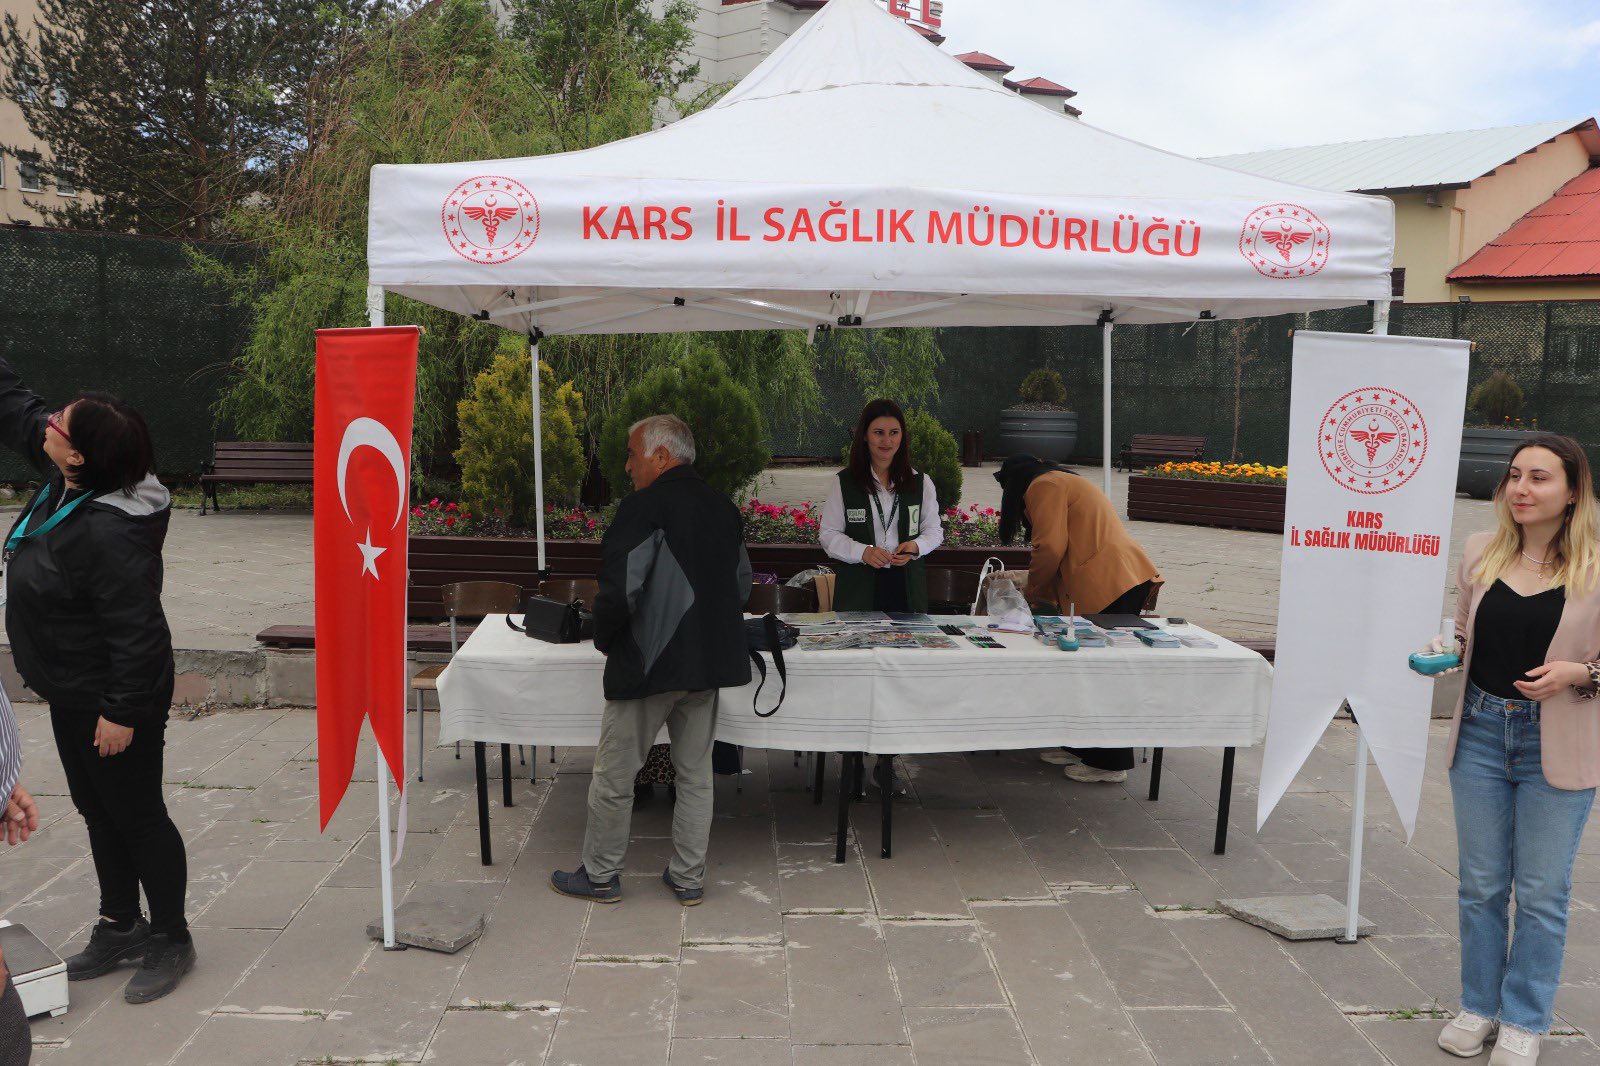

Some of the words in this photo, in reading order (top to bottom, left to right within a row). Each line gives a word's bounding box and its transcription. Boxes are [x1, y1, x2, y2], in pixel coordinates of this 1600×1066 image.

[583, 204, 694, 242] KARS
[716, 198, 752, 242] İL
[763, 200, 916, 244] SAĞLIK
[926, 208, 1202, 258] MÜDÜRLÜĞÜ
[1346, 510, 1384, 530] KARS
[1290, 526, 1301, 547] İL
[1304, 526, 1352, 549] SAĞLIK
[1353, 530, 1441, 557] MÜDÜRLÜĞÜ
